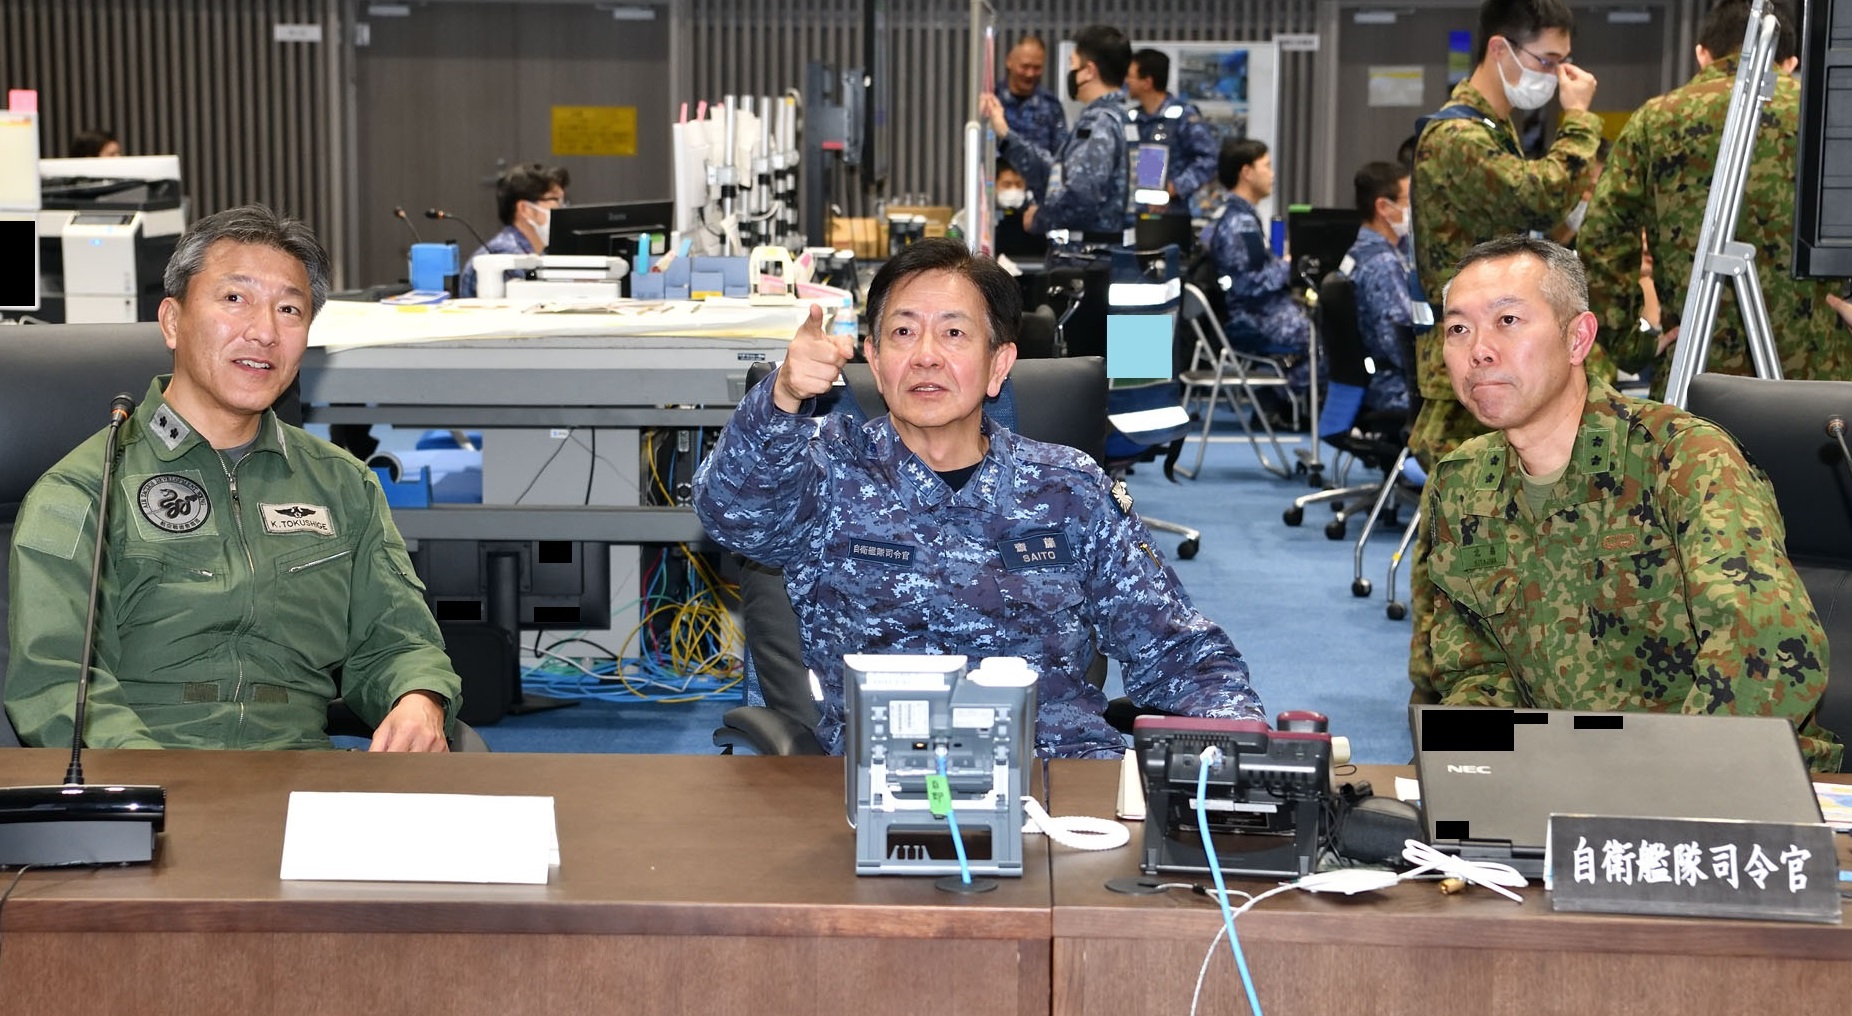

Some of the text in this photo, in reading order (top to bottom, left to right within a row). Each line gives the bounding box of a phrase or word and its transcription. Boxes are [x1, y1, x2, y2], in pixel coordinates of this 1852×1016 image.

[853, 544, 910, 561] 自衛艦隊司令官
[1022, 551, 1056, 563] SAITO
[1447, 764, 1492, 775] NEC
[1572, 836, 1813, 894] 自衛艦隊司令官
